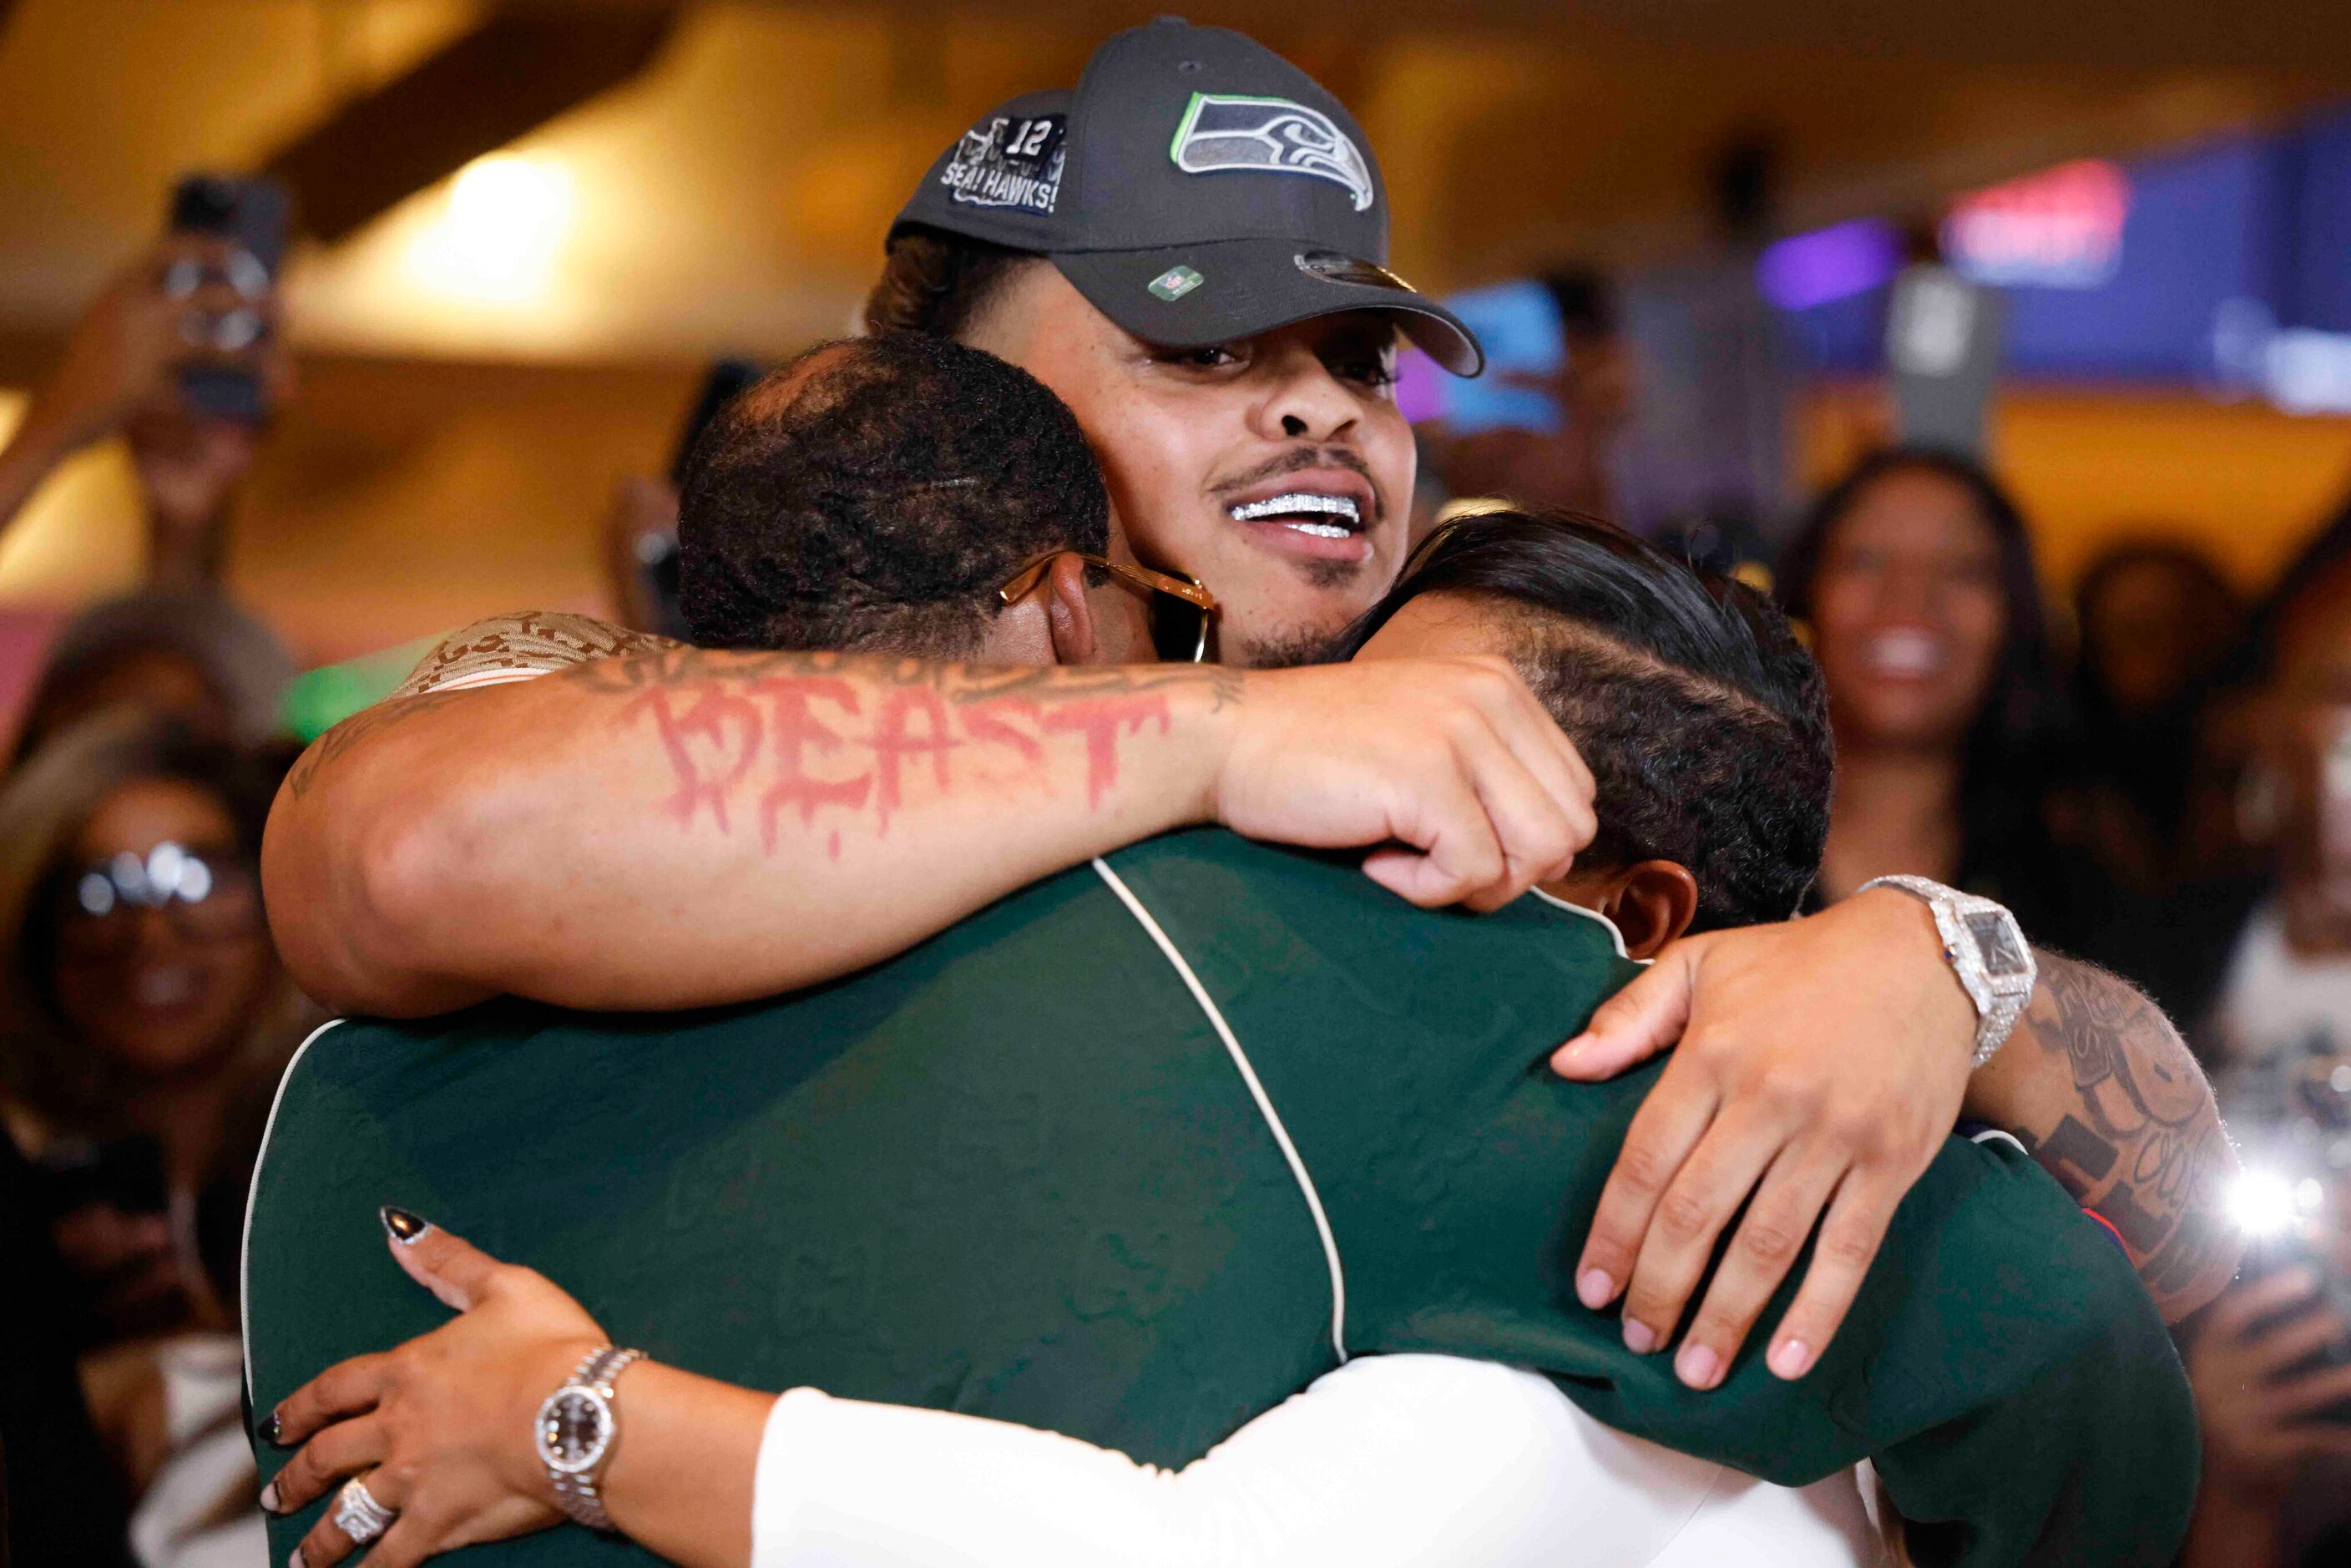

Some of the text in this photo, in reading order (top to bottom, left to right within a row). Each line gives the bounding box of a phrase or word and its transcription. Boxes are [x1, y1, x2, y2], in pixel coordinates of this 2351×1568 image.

[1006, 119, 1052, 155] 12
[983, 172, 1058, 212] HAWKS!
[623, 675, 1169, 858] BEAST
